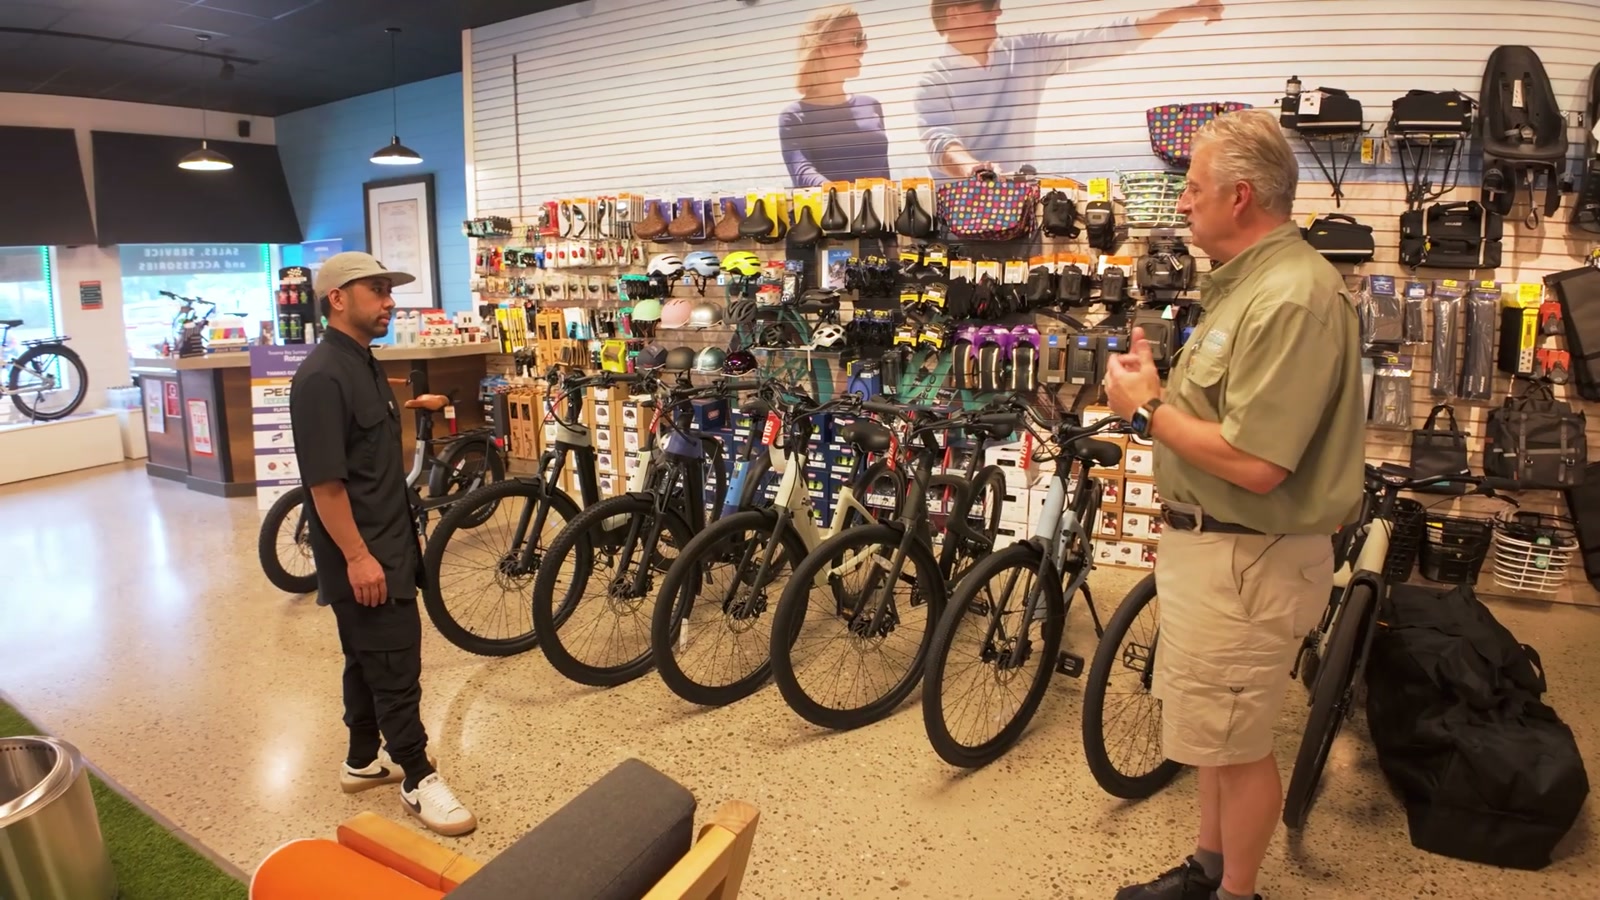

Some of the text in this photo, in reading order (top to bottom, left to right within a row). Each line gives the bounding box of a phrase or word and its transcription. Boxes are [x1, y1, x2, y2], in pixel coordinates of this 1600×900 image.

[761, 420, 774, 444] SOLD
[886, 440, 895, 468] SOLD
[1018, 440, 1029, 469] SOLD
